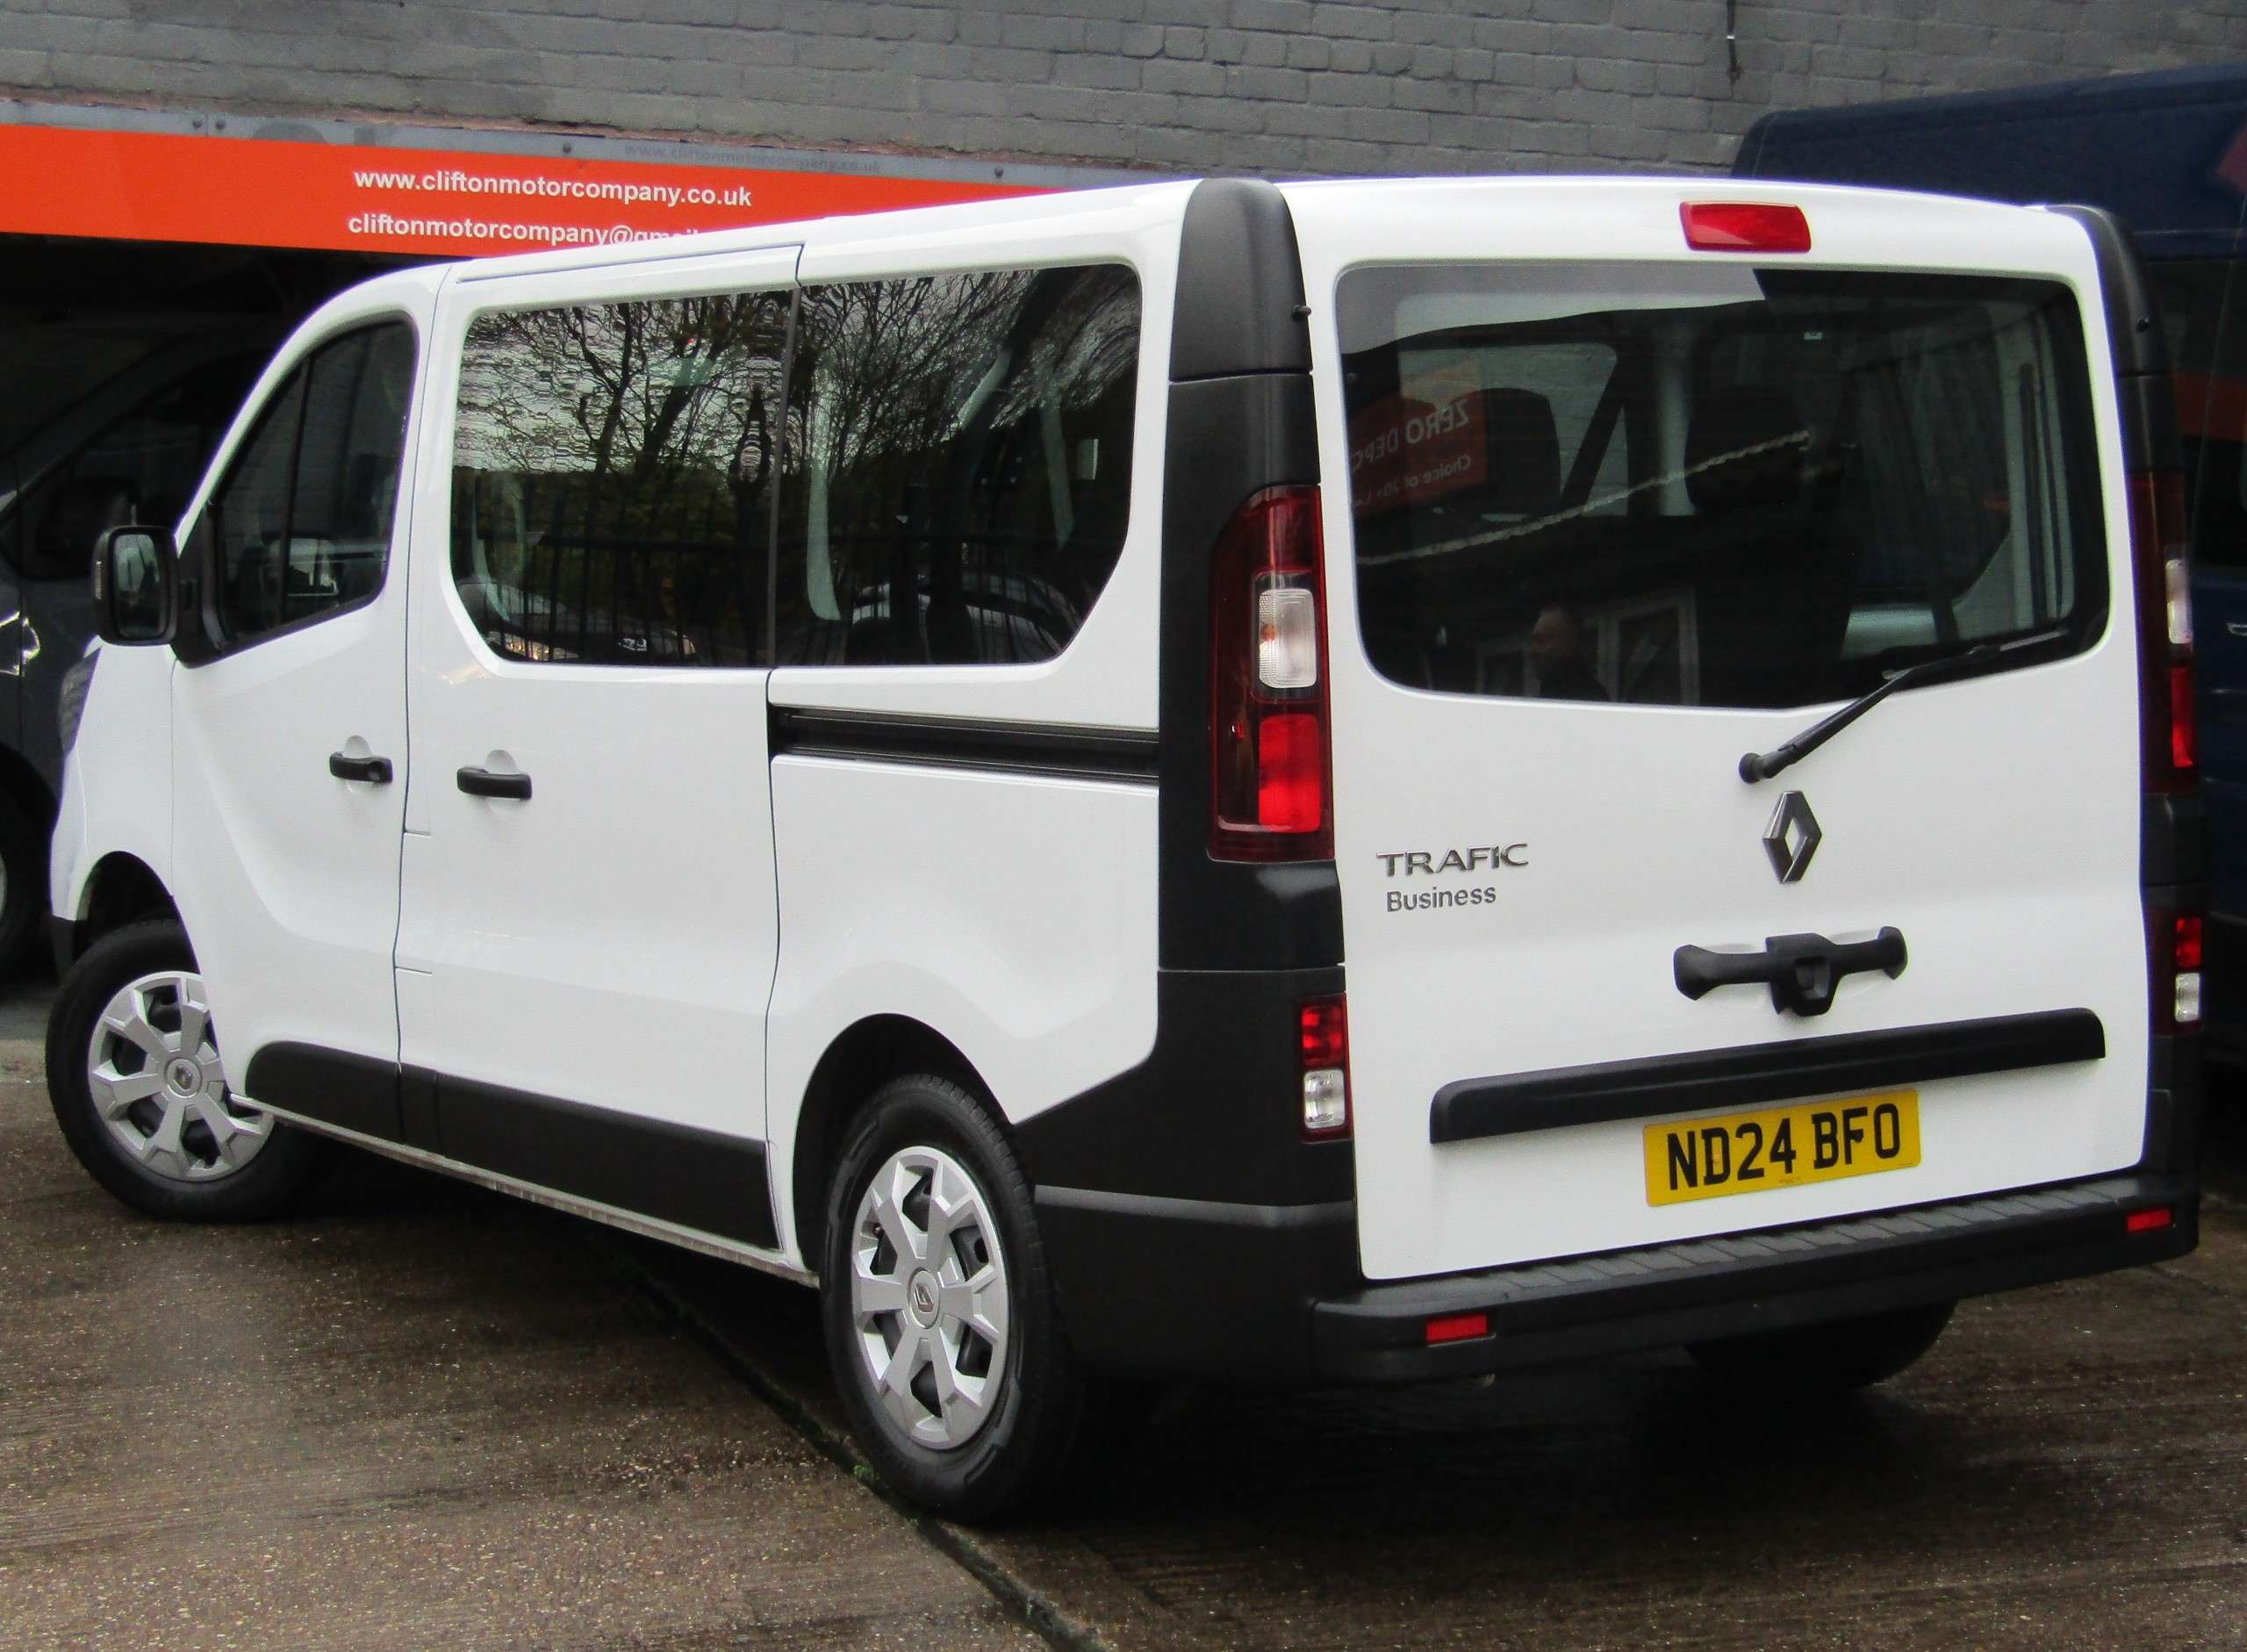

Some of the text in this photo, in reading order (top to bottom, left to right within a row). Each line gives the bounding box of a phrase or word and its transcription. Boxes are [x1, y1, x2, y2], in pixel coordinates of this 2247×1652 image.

[354, 169, 752, 207] www.cliftonmotorcompany.co.uk
[1375, 843, 1529, 877] TRAFIC
[1386, 887, 1497, 912] Business
[1667, 1103, 1900, 1191] ND24 BFO
